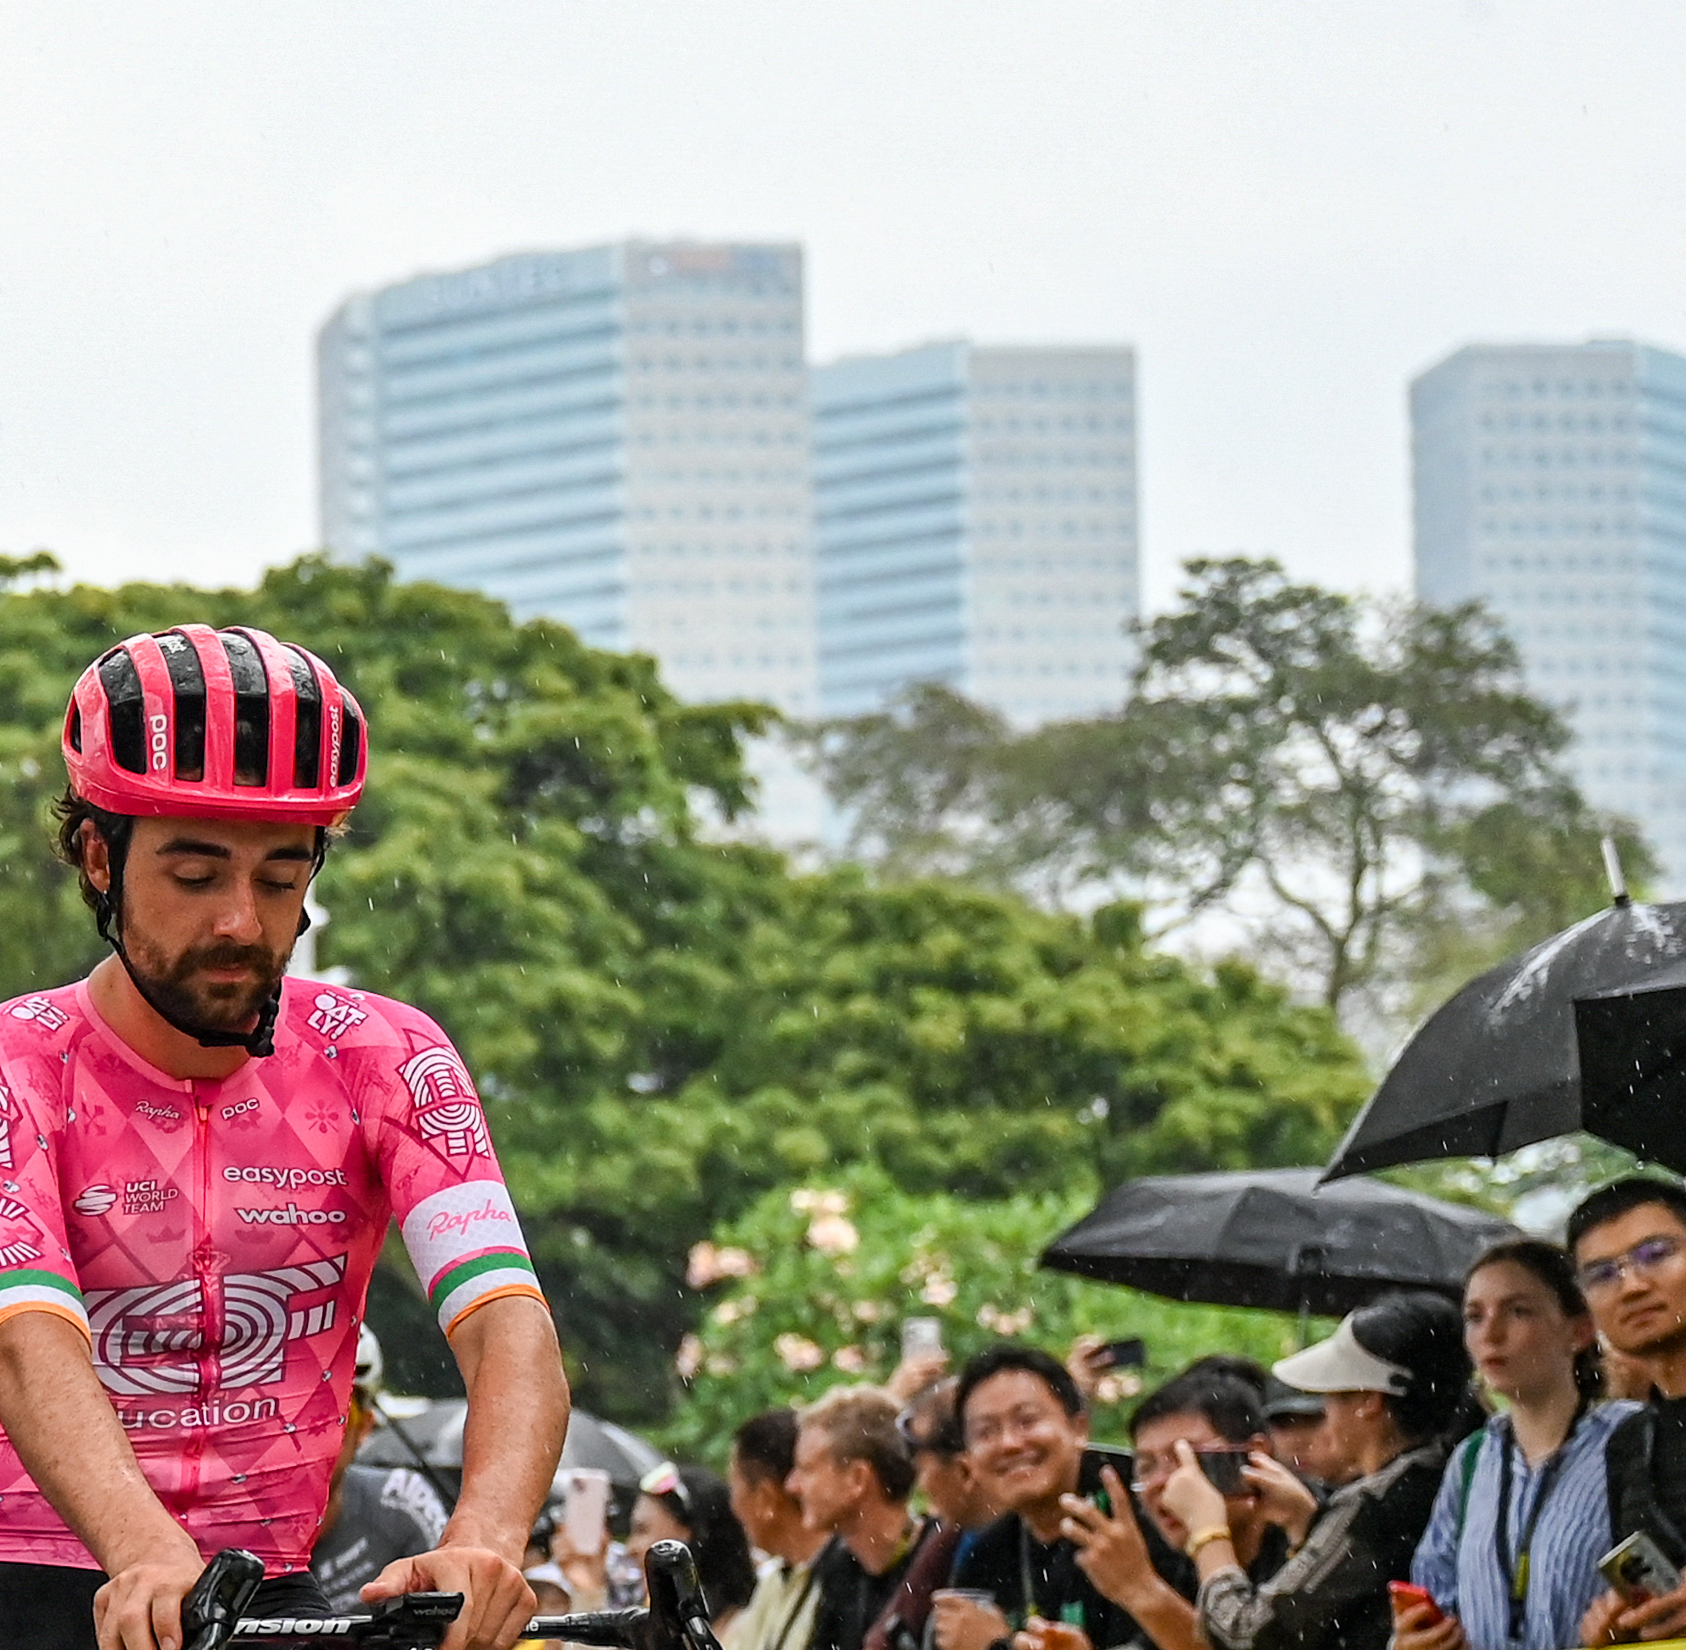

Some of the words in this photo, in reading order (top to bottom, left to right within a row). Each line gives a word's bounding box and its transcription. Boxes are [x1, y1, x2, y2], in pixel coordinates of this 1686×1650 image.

[126, 1180, 156, 1193] UCI
[222, 1165, 348, 1190] easypost
[124, 1188, 178, 1203] WORLD
[123, 1200, 165, 1215] TEAM
[236, 1202, 347, 1225] wahoo
[118, 1397, 276, 1430] ucation
